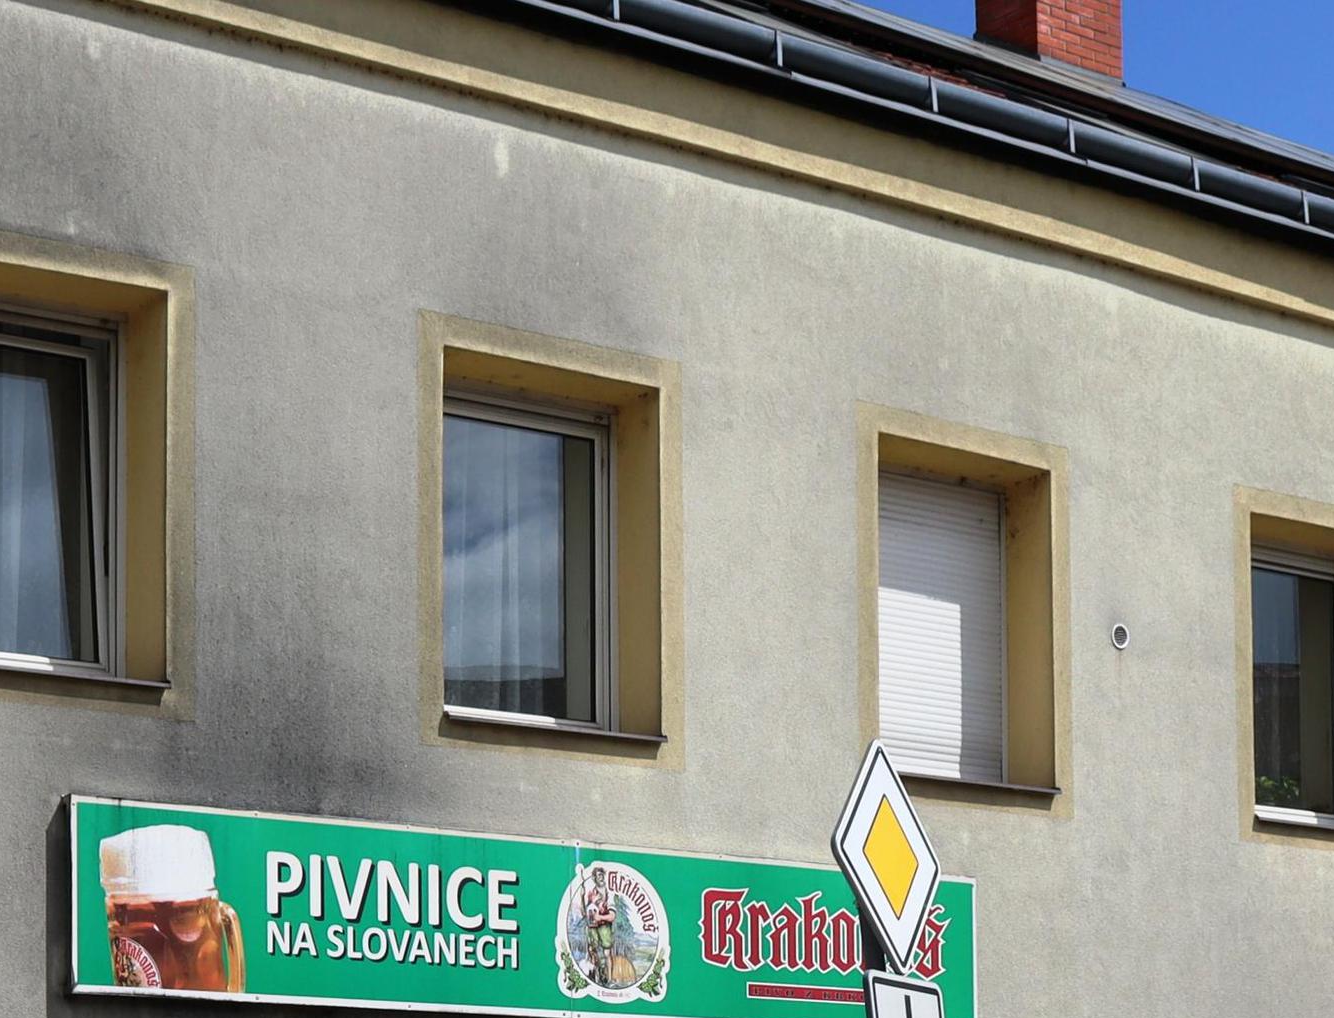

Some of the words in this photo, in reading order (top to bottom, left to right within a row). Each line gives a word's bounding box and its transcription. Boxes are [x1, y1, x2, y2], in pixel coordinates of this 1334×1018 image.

[266, 850, 519, 932] PIVNICE
[266, 920, 318, 957] NA
[326, 924, 519, 969] SLOVANECH
[699, 887, 952, 980] Krakoš
